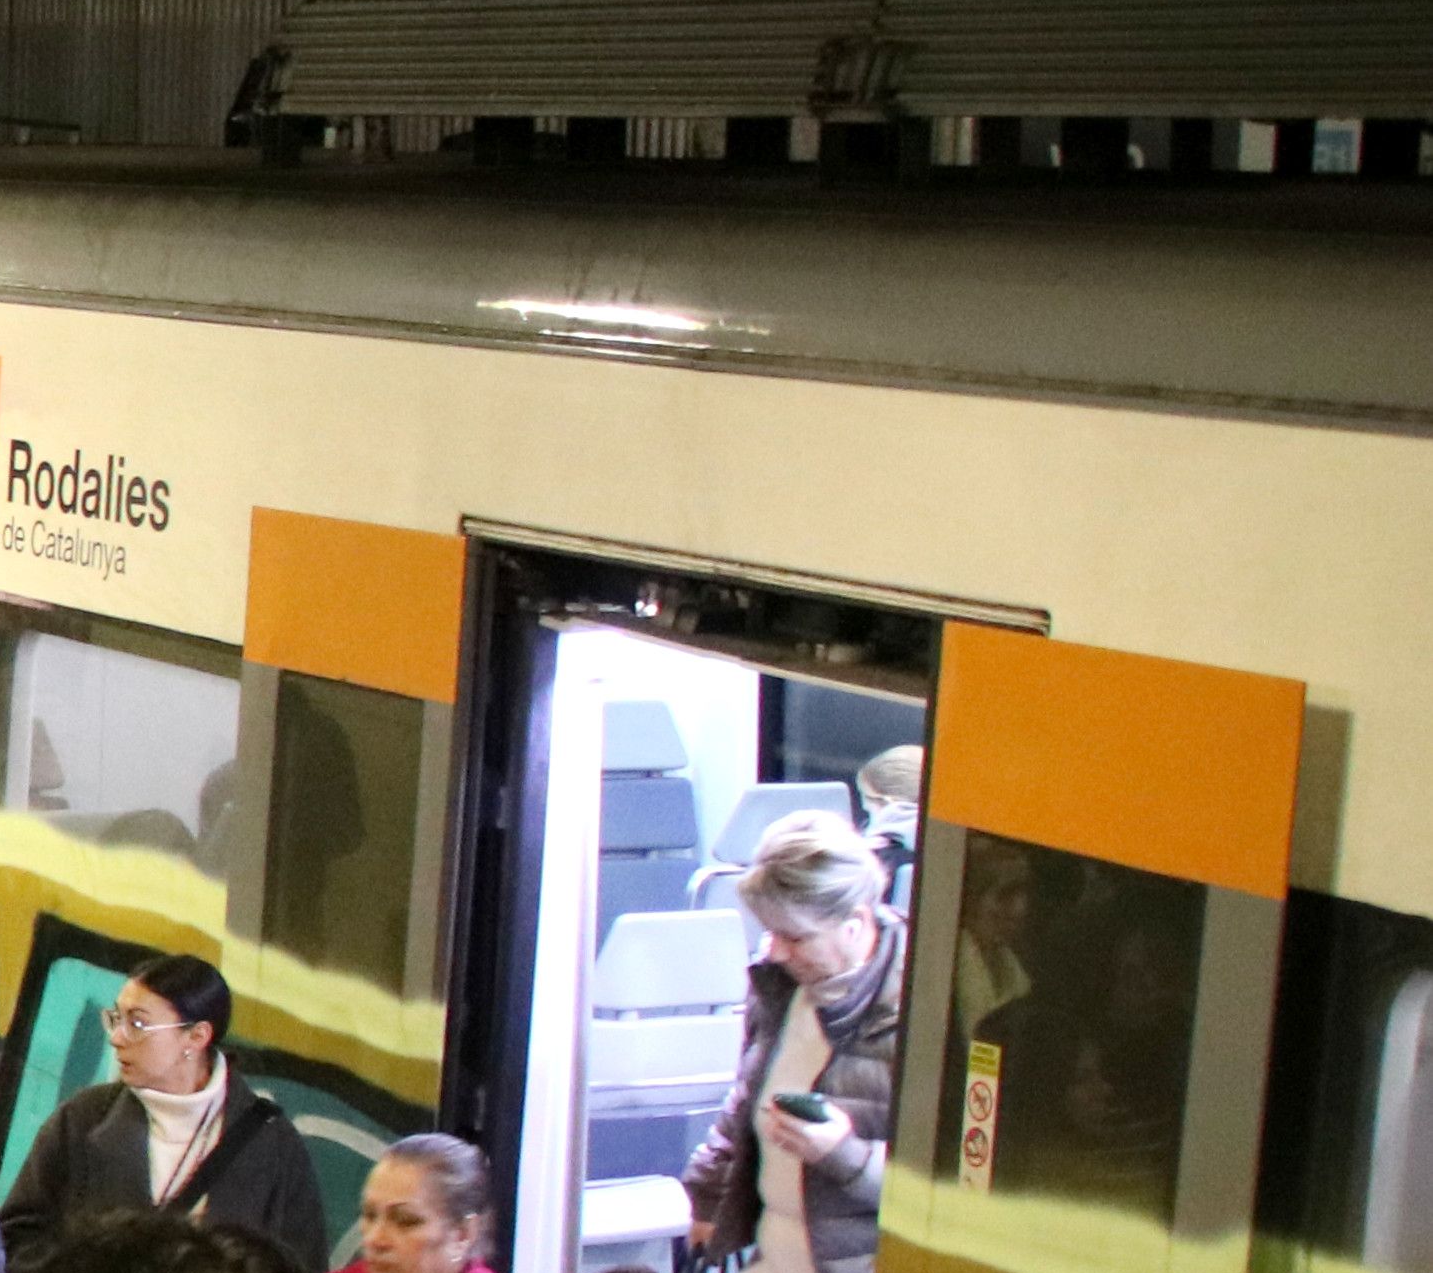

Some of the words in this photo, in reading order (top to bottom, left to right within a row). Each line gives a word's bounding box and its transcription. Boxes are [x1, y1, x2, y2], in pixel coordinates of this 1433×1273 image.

[6, 438, 171, 532] Rodalies
[2, 516, 26, 554] de
[30, 519, 127, 581] Catalunya
